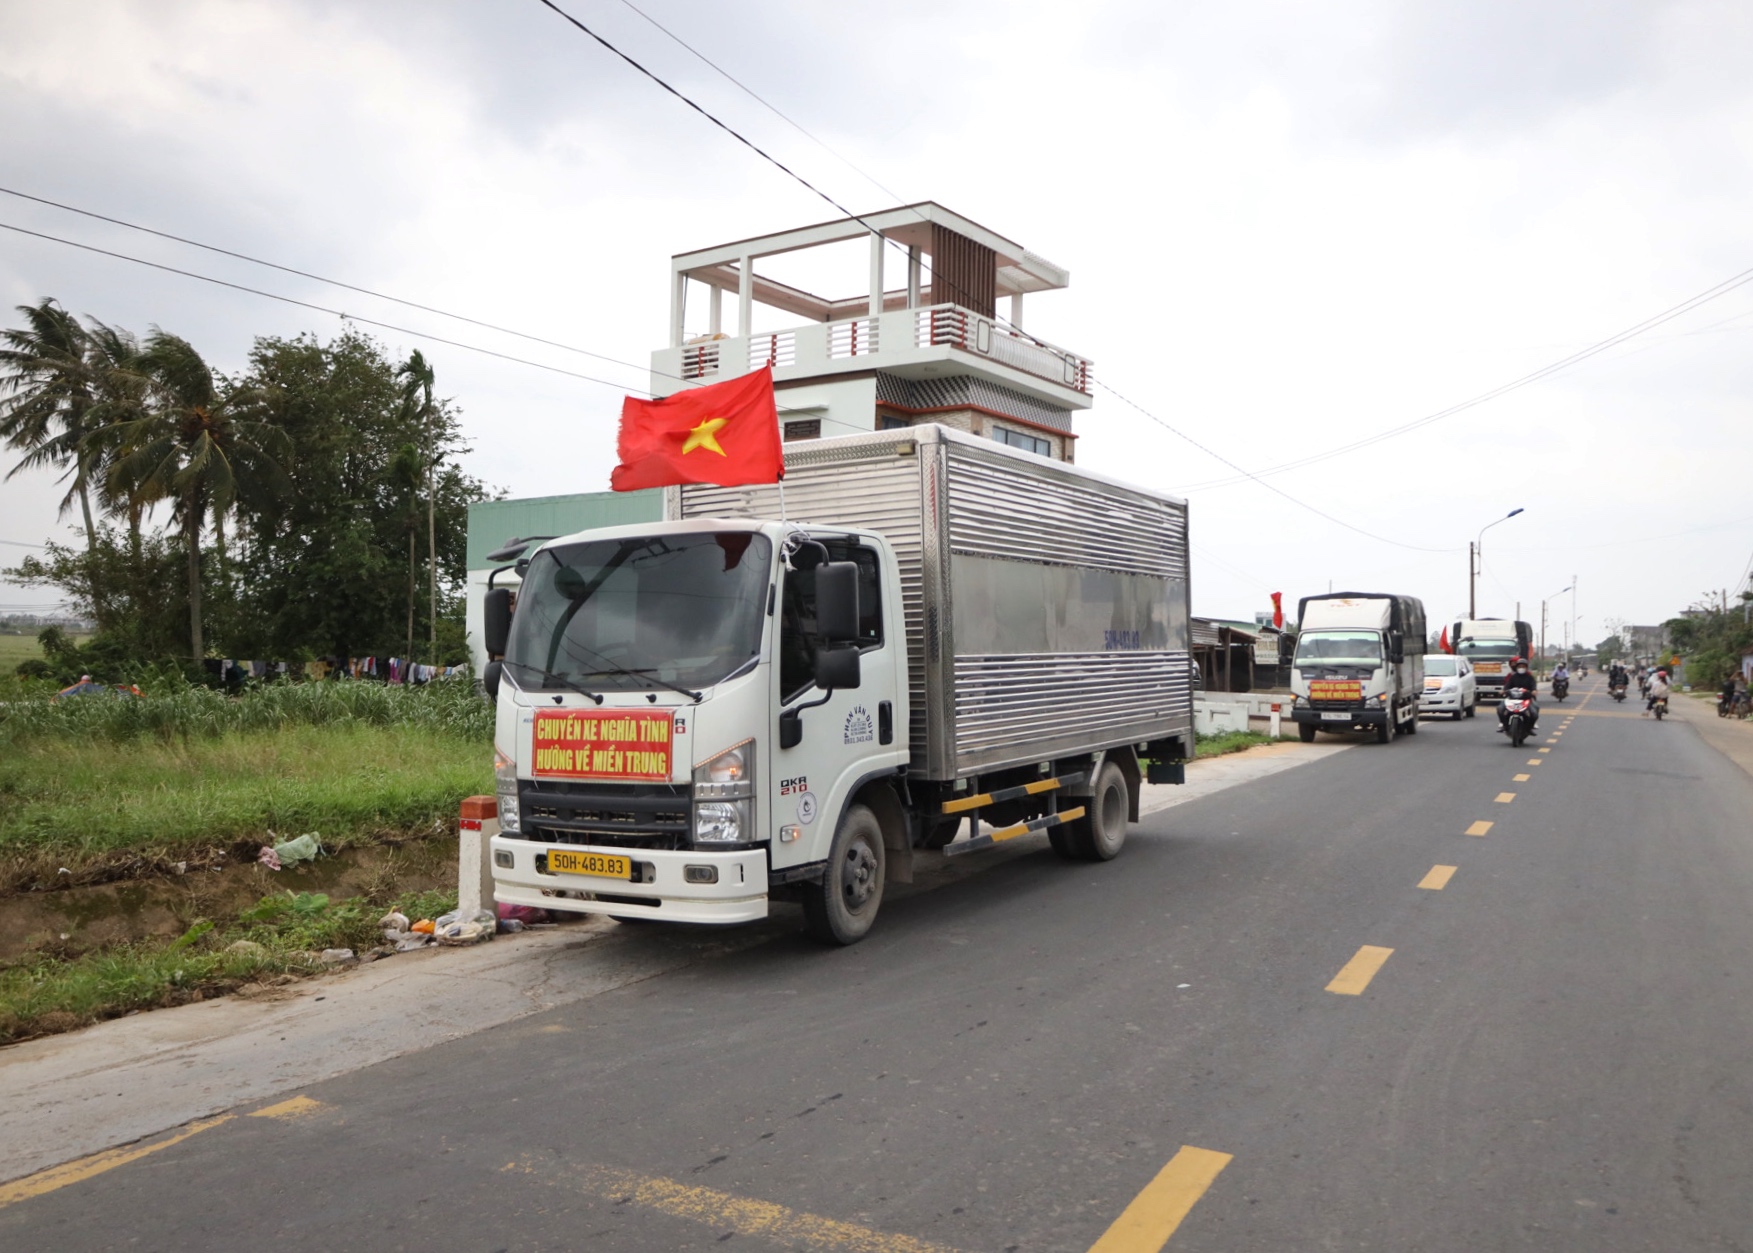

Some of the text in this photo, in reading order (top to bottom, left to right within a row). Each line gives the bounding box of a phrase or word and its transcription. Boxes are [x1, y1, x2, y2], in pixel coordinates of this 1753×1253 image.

[537, 713, 669, 743] CHUYẾN XE NGHĨA TÌNH
[575, 744, 591, 771] VỀ
[593, 744, 623, 772] MIỀN
[626, 751, 667, 774] TRUNG
[781, 776, 807, 788] QKR
[781, 784, 808, 796] 210
[554, 853, 624, 874] 50H-483.83
